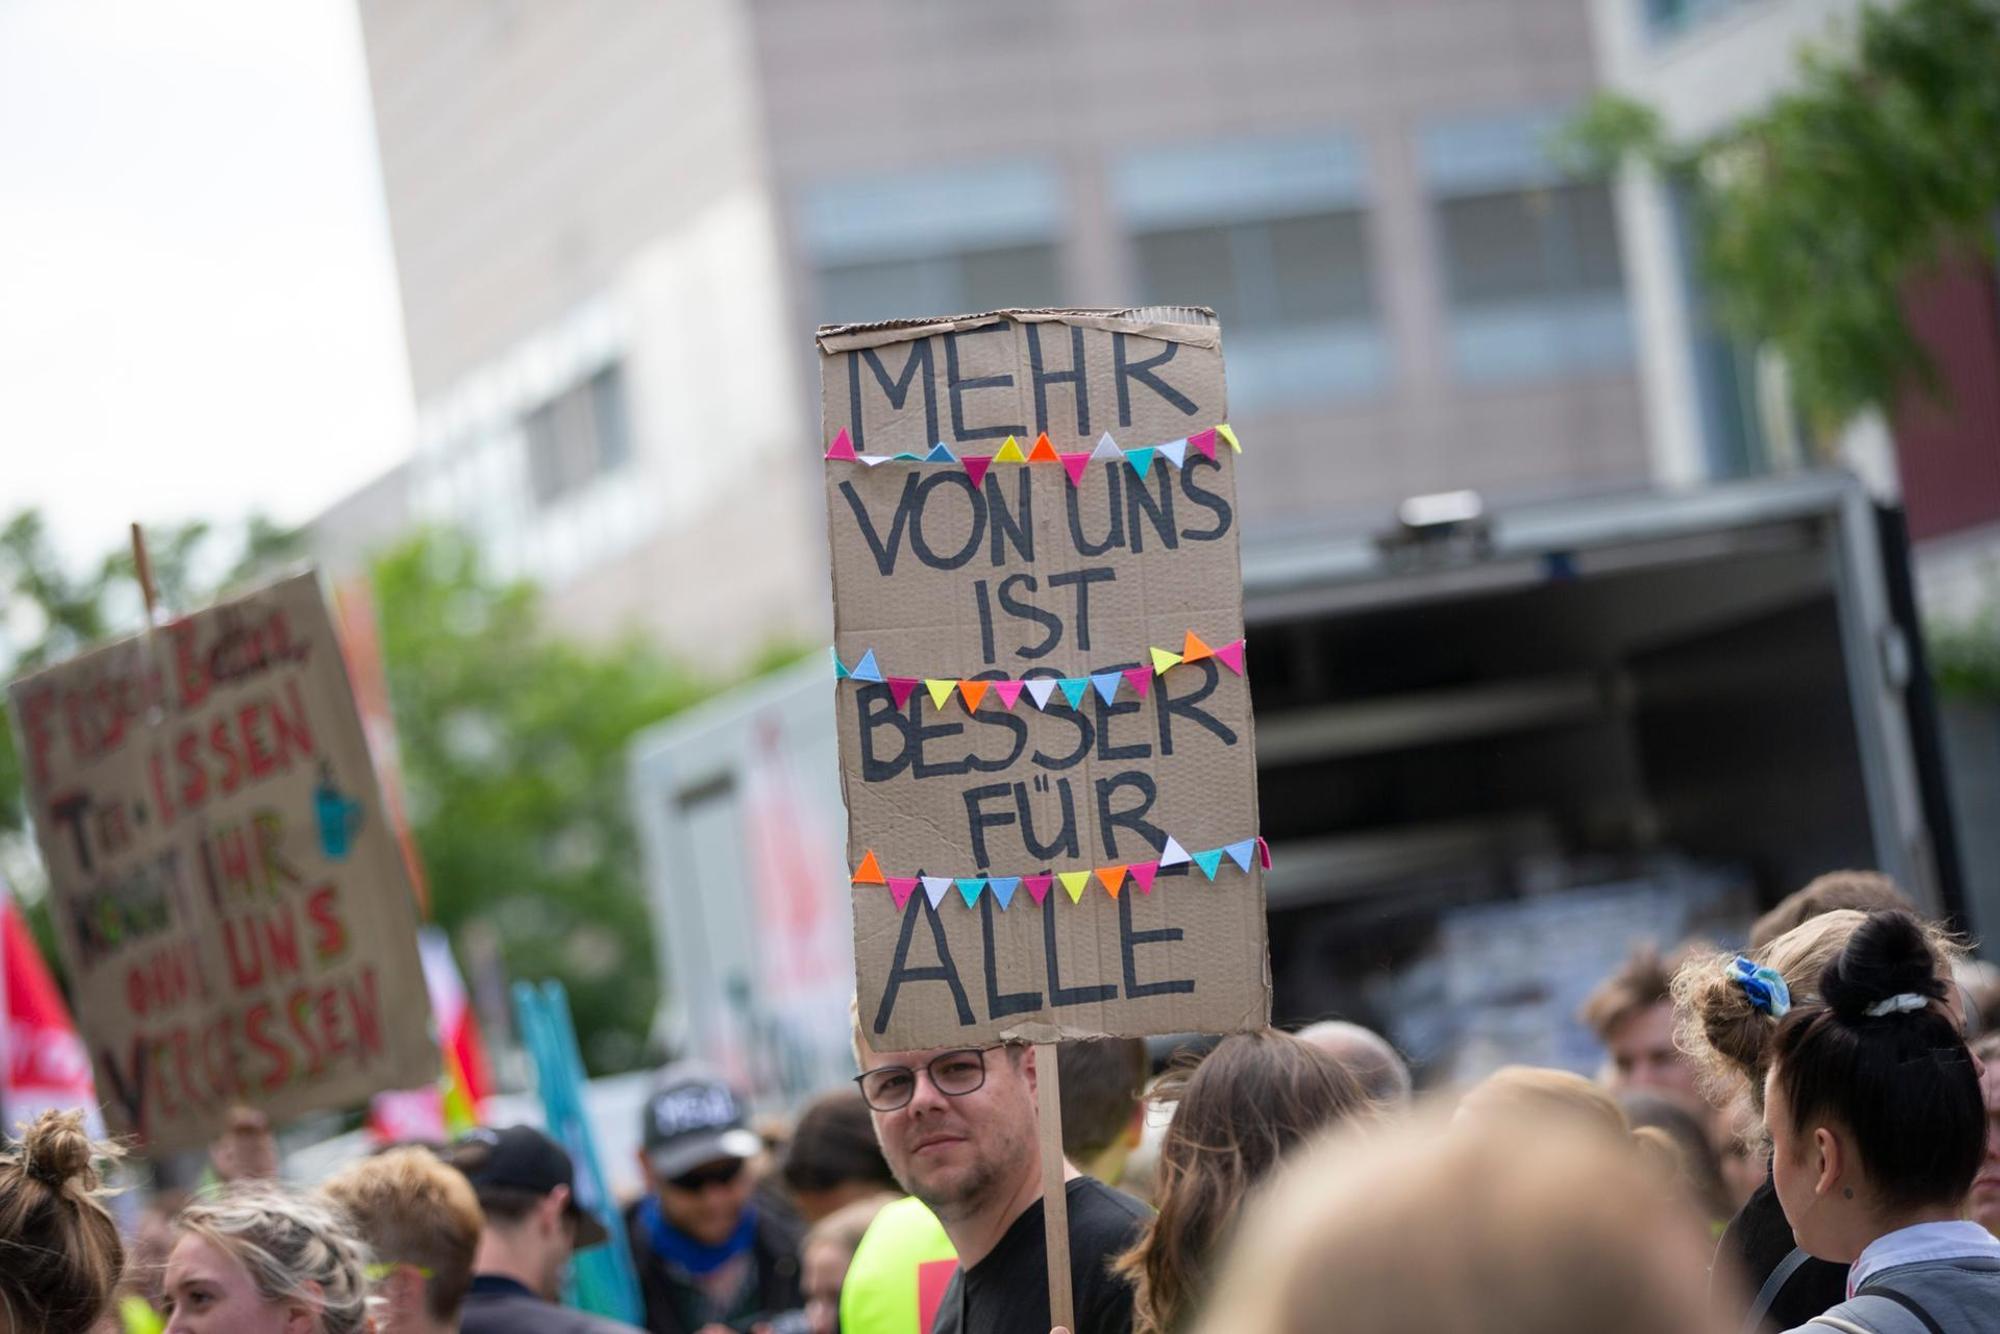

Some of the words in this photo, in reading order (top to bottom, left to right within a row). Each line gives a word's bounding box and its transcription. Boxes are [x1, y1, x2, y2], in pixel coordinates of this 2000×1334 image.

[847, 321, 1200, 452] MEHR
[838, 466, 1036, 576] VON
[1065, 453, 1233, 557] UNS
[973, 566, 1117, 665] IST
[855, 656, 1238, 783] BESSER
[961, 770, 1172, 870] FÜR
[222, 883, 350, 991] UNS
[872, 862, 1196, 1034] ALLE
